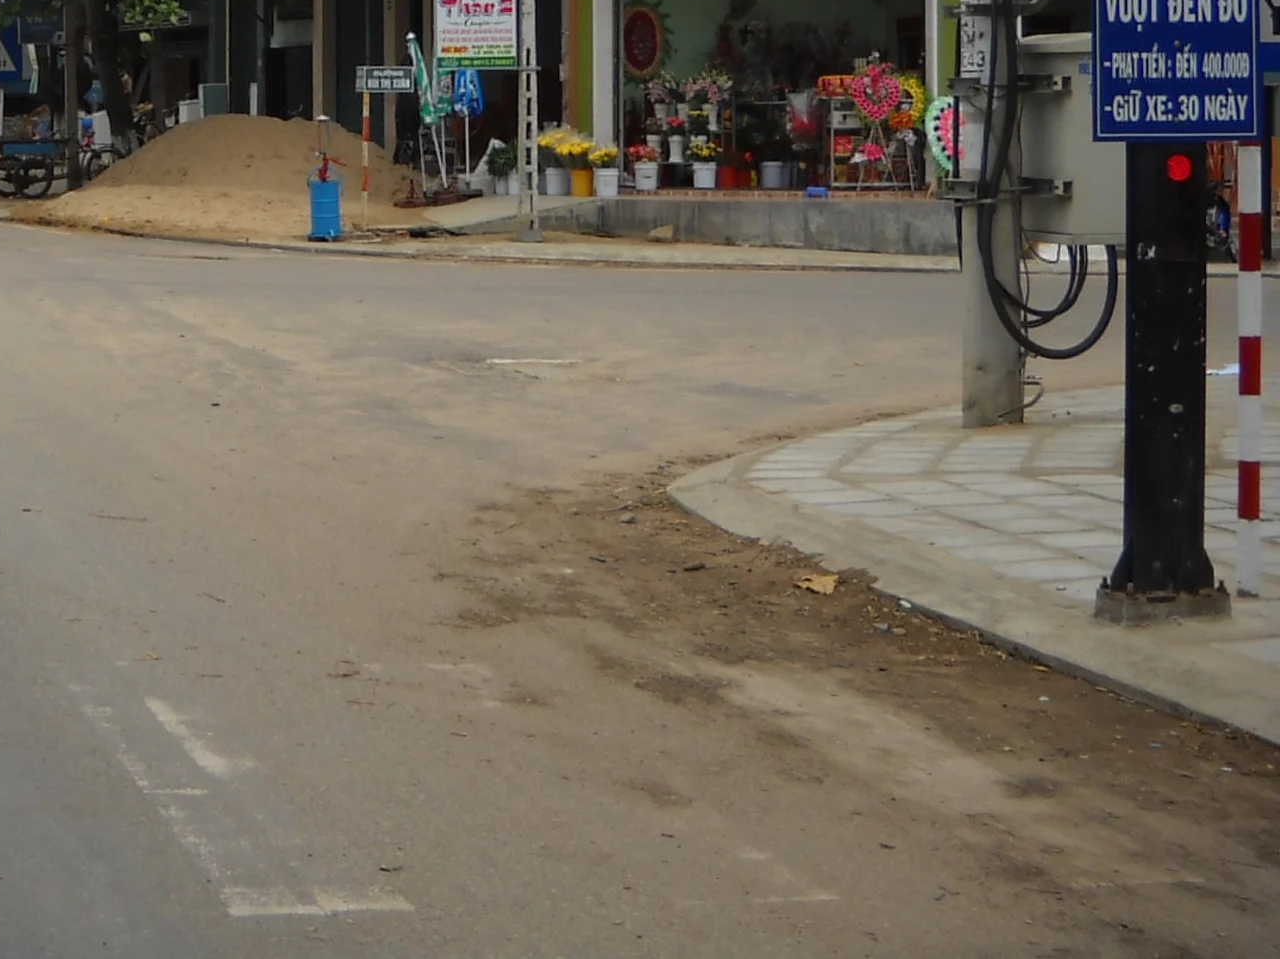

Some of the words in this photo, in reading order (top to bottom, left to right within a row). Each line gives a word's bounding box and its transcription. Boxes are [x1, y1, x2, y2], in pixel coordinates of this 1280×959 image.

[1175, 43, 1197, 79] ĐẾN
[1178, 95, 1199, 121] 30
[1204, 87, 1249, 121] NGÀY
